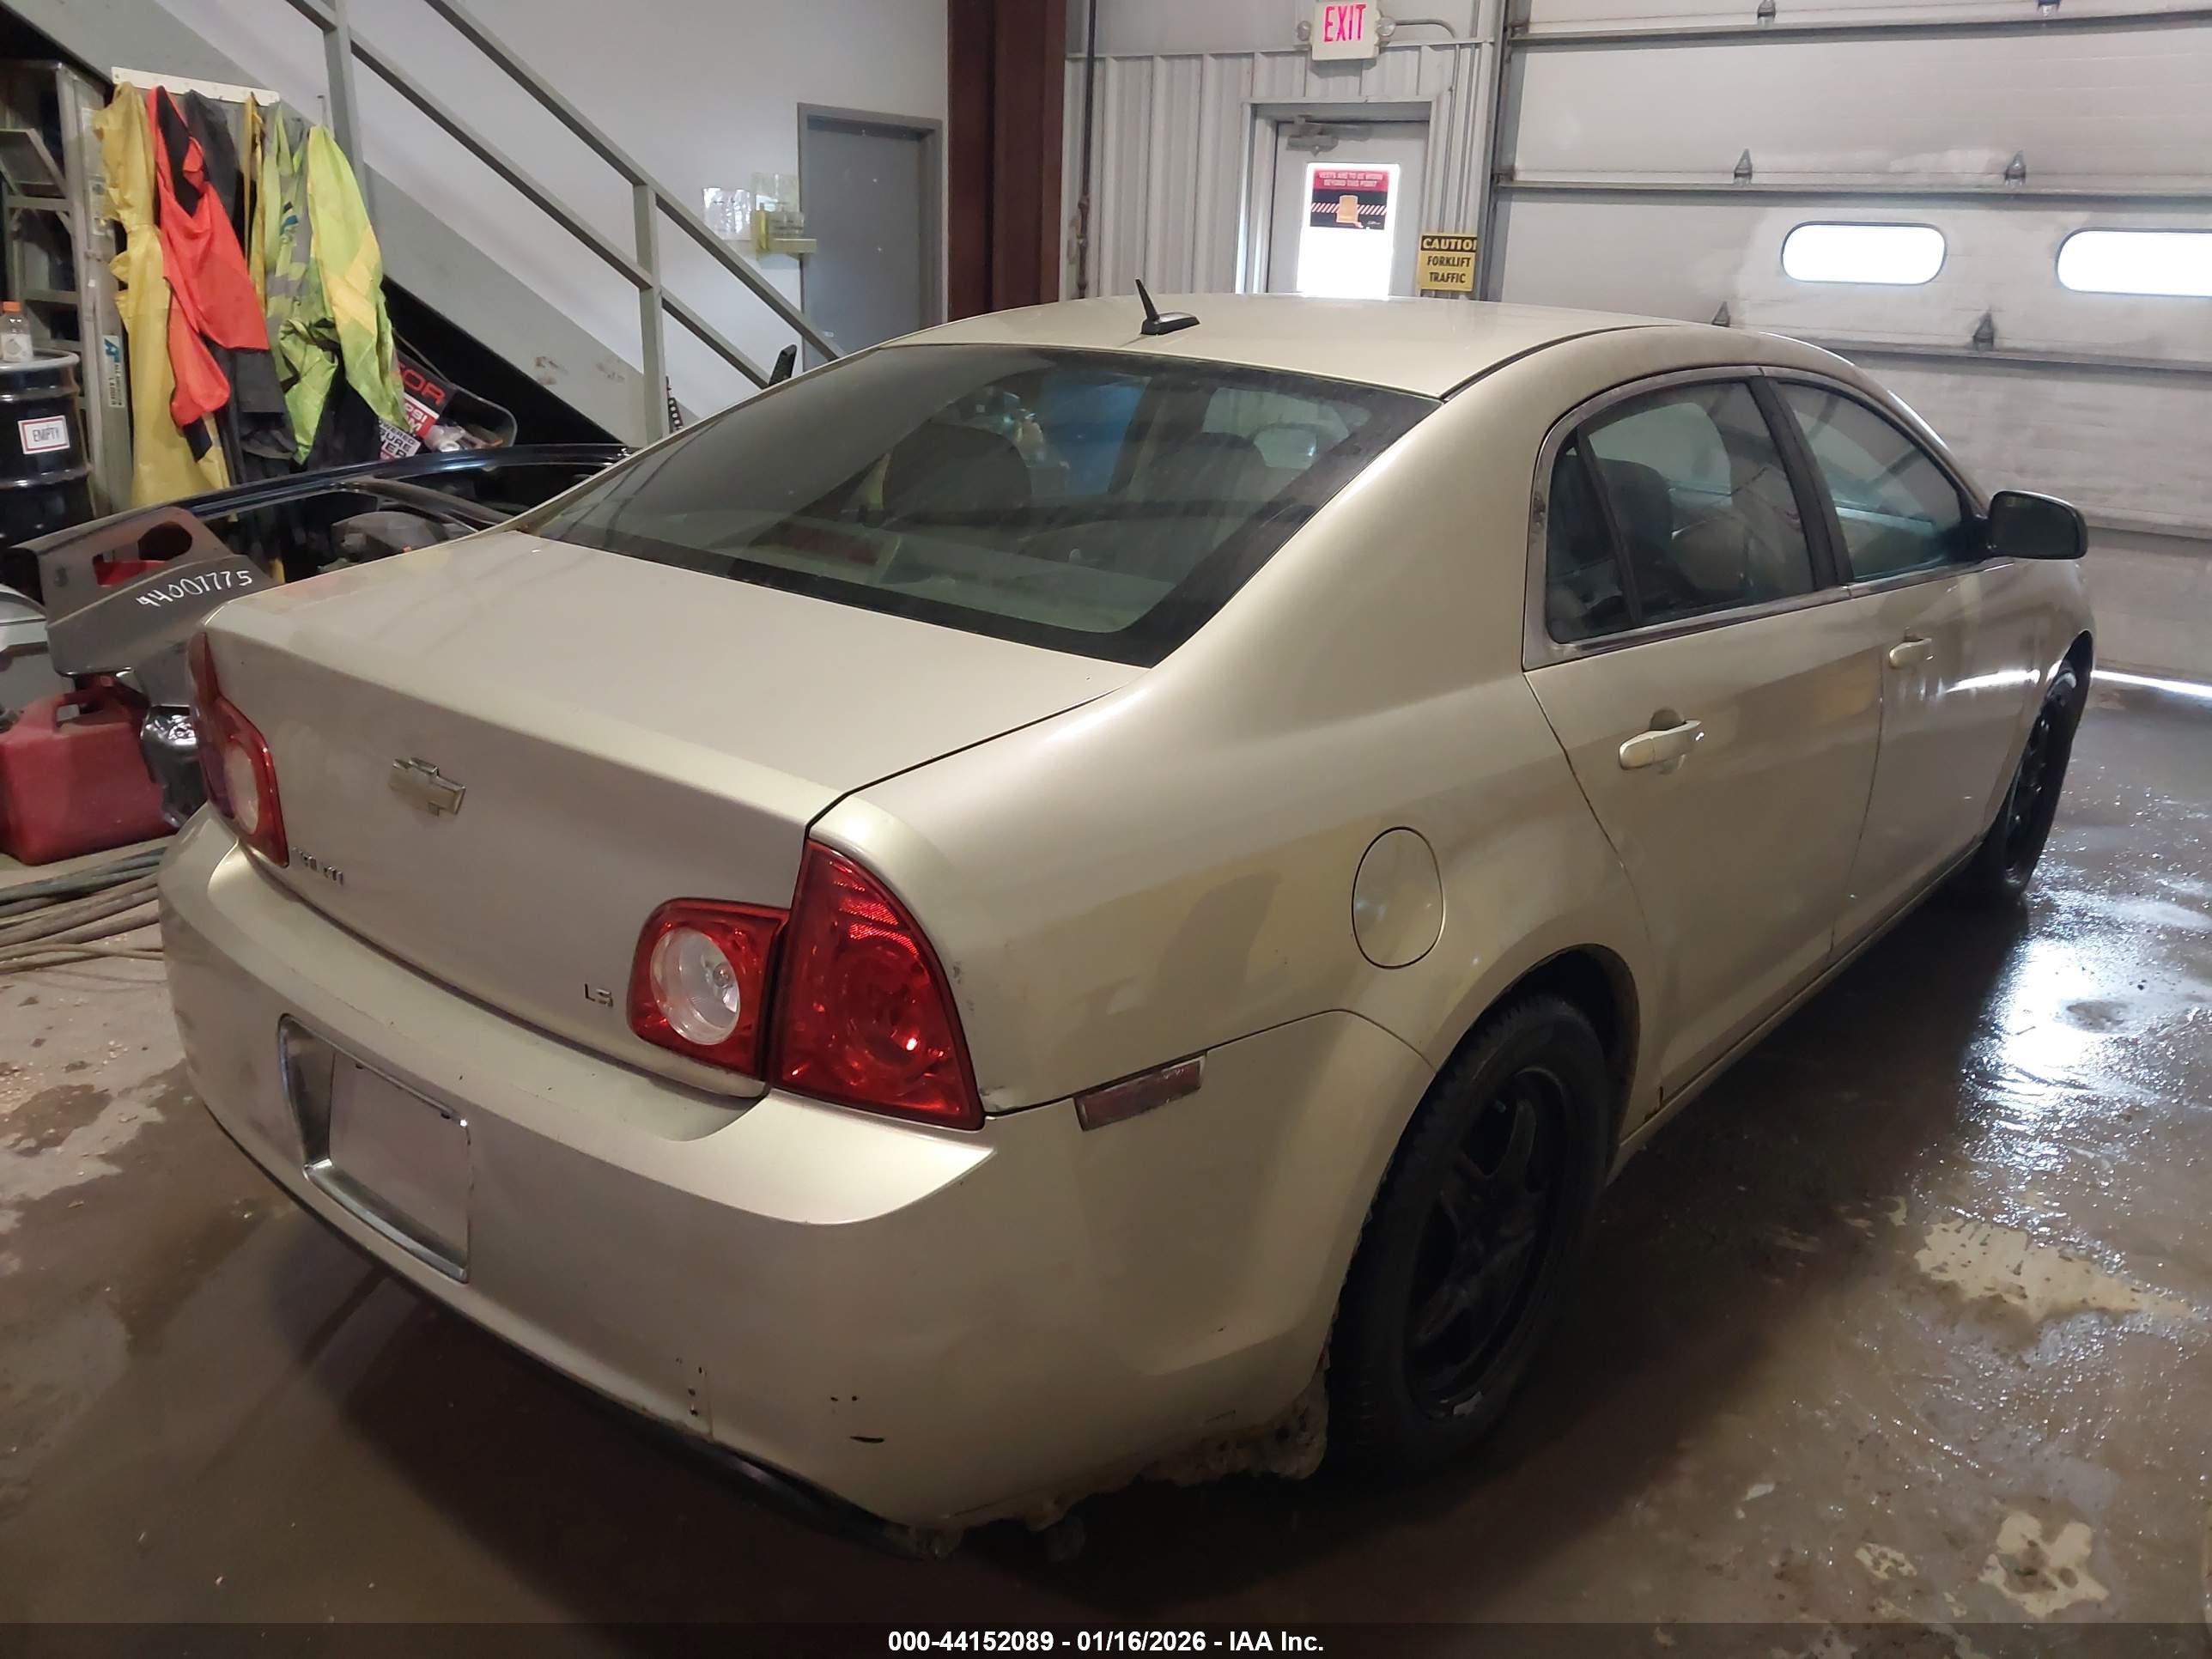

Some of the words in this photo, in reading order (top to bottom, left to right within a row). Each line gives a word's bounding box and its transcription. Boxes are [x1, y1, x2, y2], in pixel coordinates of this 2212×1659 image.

[1323, 4, 1366, 42] EXIT
[1427, 255, 1471, 267] FORKLIFT
[1429, 271, 1466, 283] TRAFFIC
[398, 362, 445, 405] OR
[585, 983, 614, 1007] LS
